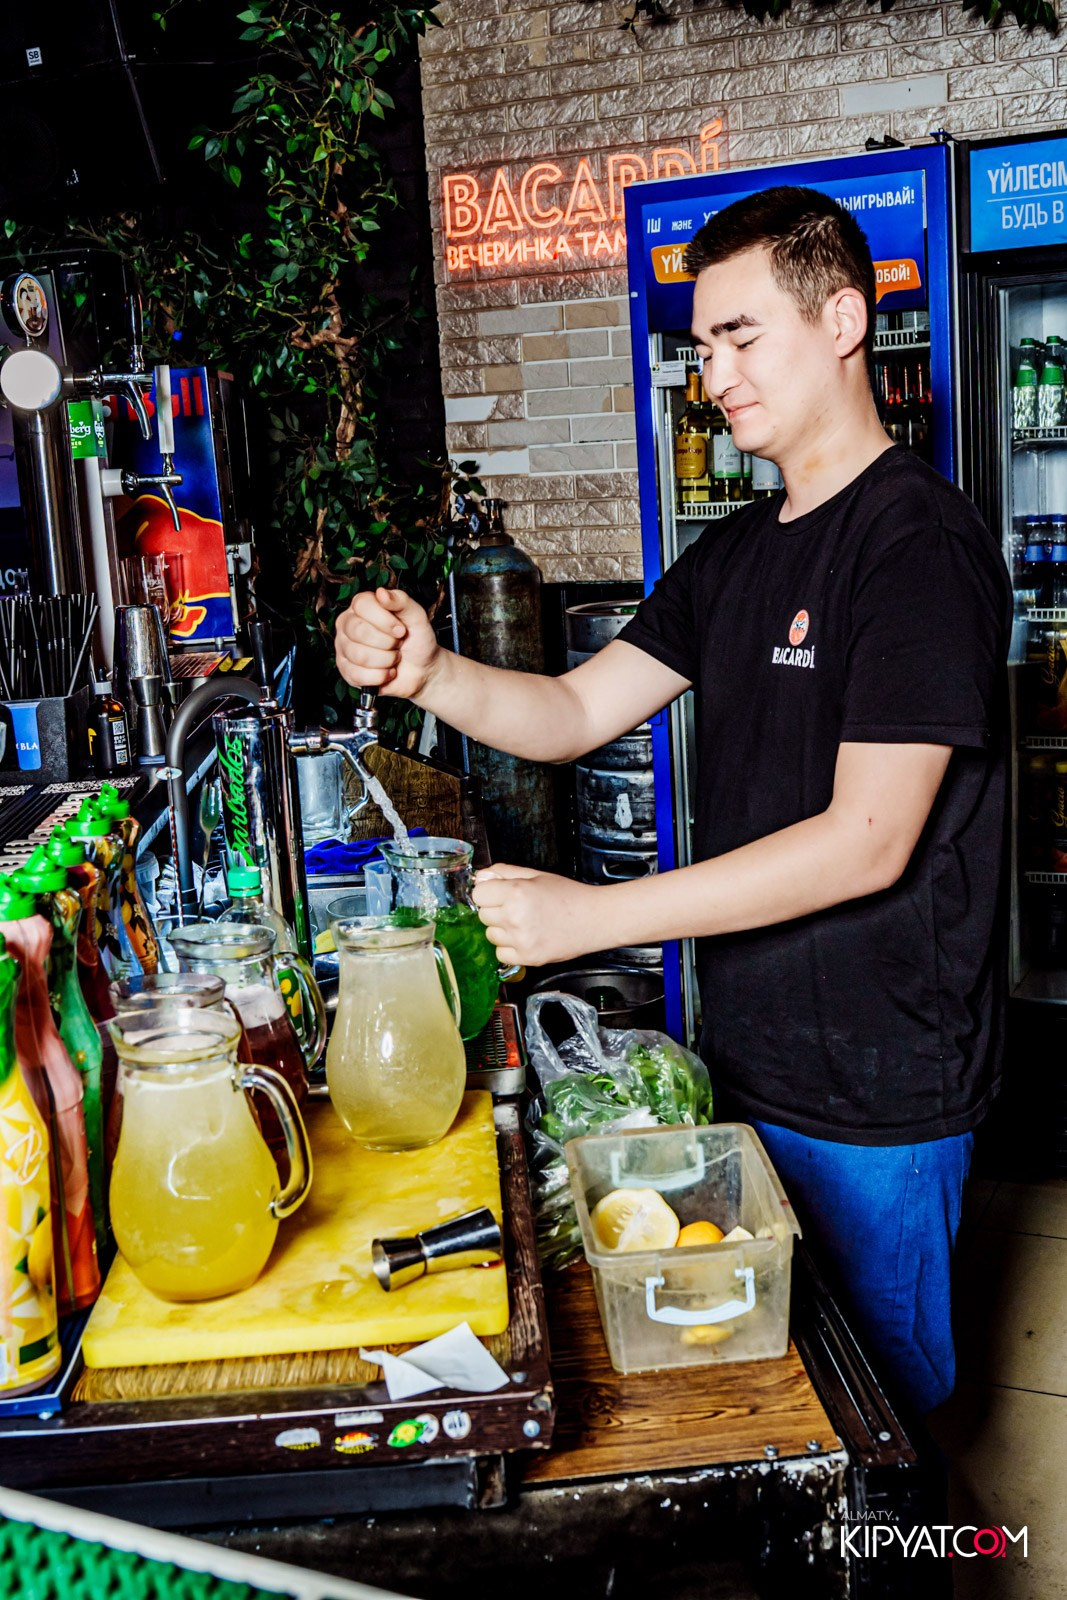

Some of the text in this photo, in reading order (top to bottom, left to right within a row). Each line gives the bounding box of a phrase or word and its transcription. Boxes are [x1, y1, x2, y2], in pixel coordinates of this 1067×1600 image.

[1002, 200, 1065, 230] БУДЬ В
[448, 234, 572, 271] ВЕЧЕРИНКА
[876, 264, 911, 284] ОБОЙ!
[772, 645, 815, 668] BACARDÍ
